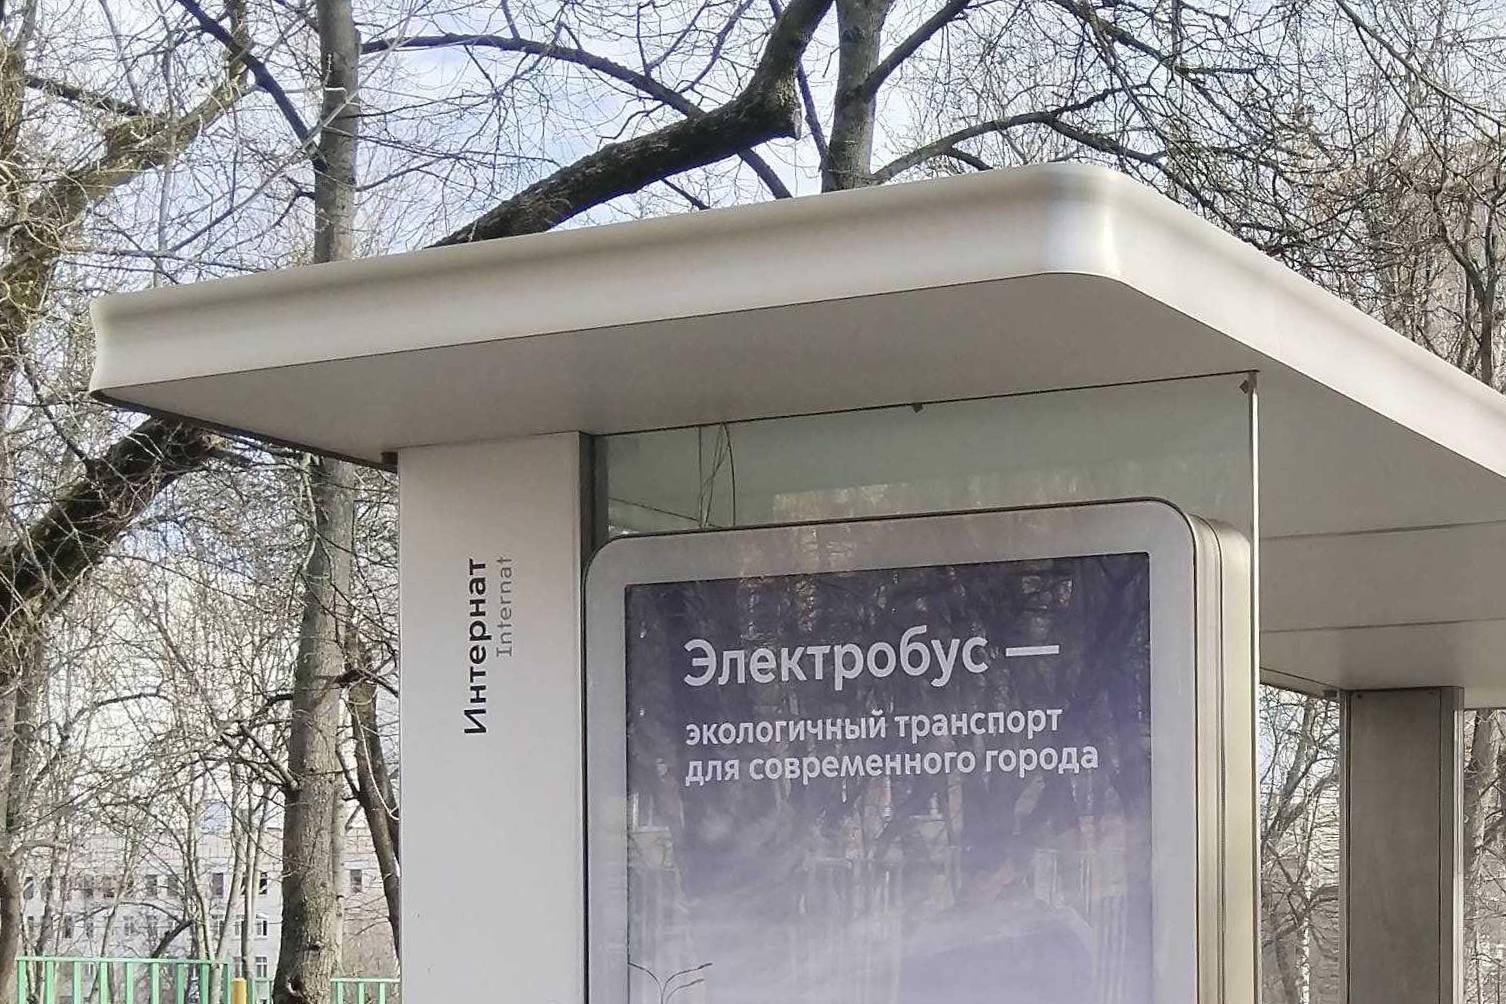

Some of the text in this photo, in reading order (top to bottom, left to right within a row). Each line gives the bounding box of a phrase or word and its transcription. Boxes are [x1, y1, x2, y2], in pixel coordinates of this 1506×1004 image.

[496, 557, 513, 657] Internat
[464, 558, 492, 734] Интернат
[684, 624, 989, 691] Электробус
[685, 708, 1062, 746] экологичный транспорт
[685, 743, 1099, 787] для современного города
